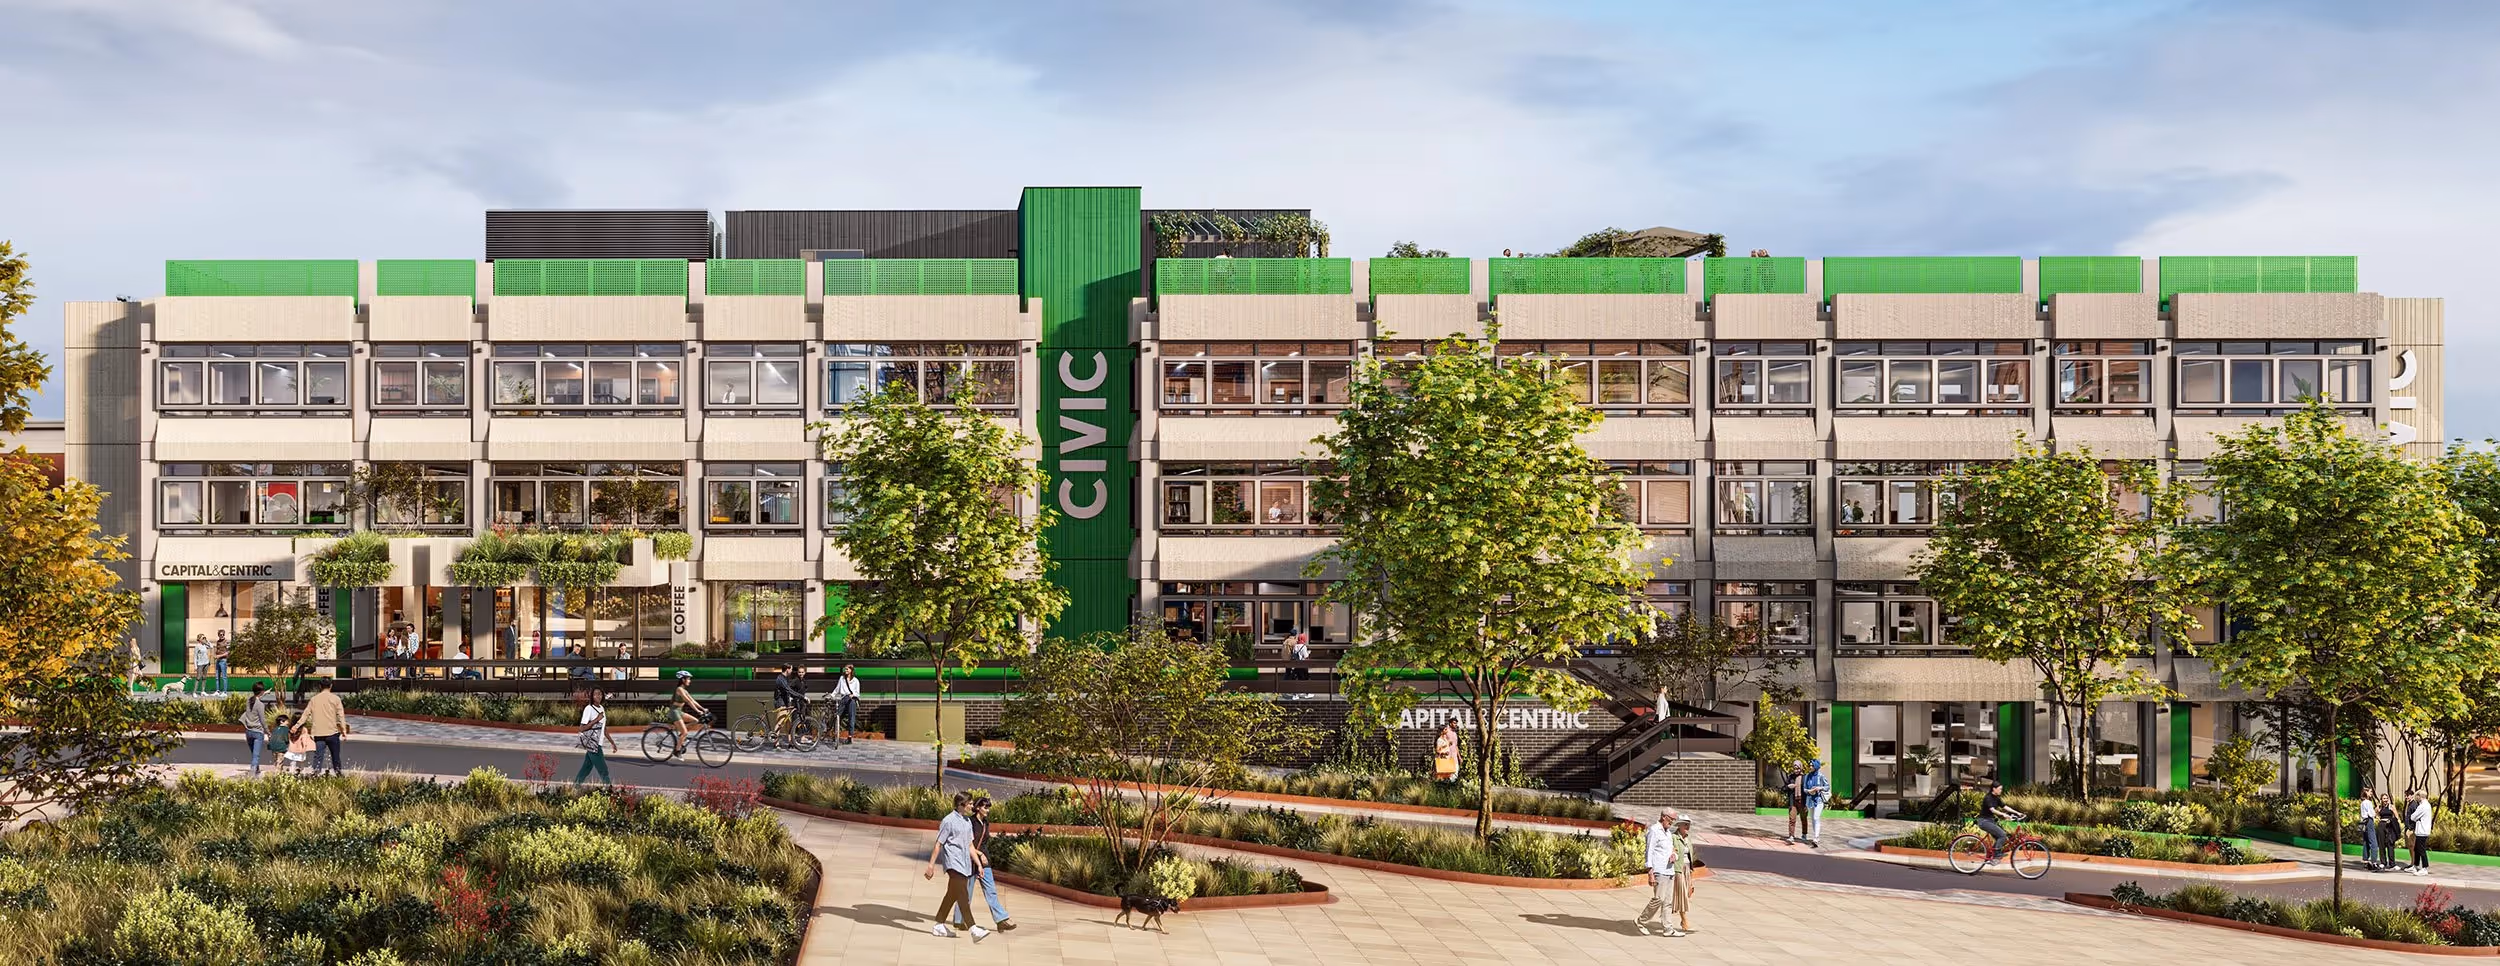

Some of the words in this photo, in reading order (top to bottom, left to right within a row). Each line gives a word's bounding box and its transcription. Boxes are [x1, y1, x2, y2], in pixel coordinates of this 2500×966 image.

[1058, 350, 1108, 520] CIVIC
[161, 564, 272, 577] CAPITAL&CENTRIC
[674, 586, 685, 635] COFFEE
[1380, 708, 1589, 730] APITAL&CENTRIC
